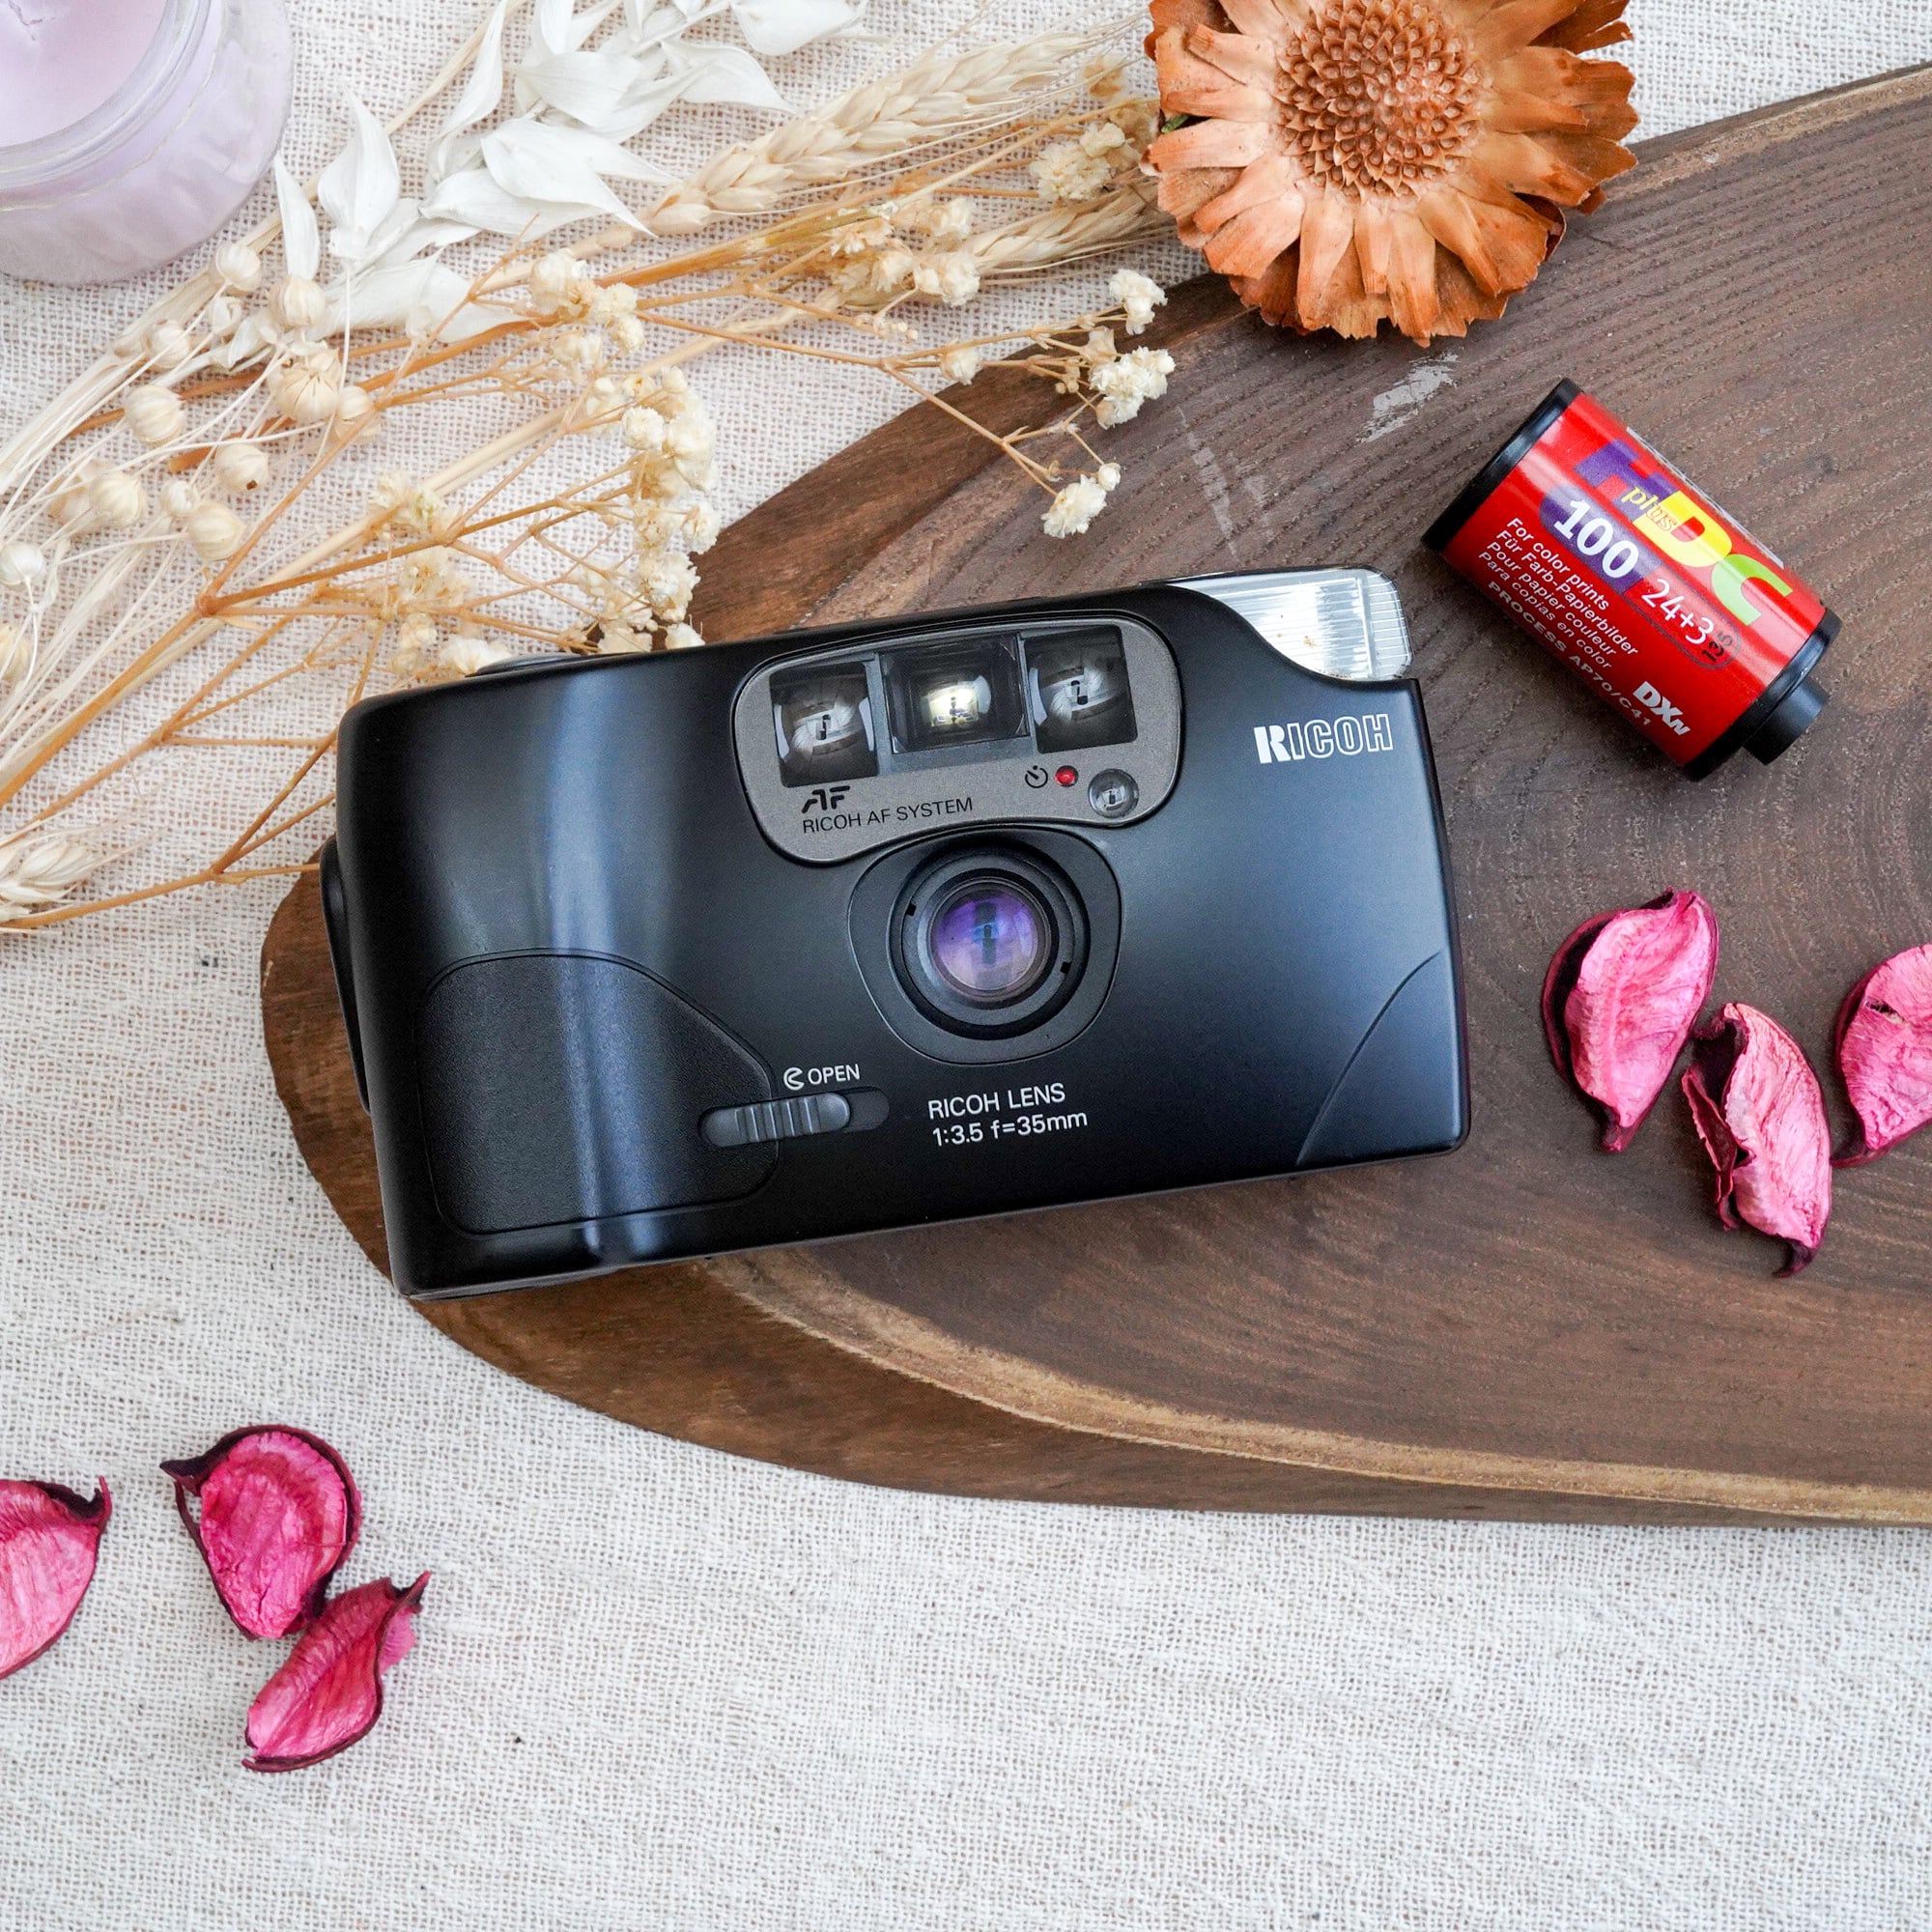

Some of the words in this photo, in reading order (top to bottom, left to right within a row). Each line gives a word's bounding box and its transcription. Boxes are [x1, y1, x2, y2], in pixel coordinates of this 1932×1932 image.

[1621, 487, 1677, 531] plus
[1507, 518, 1534, 541] For
[1533, 542, 1571, 573] color
[1566, 574, 1609, 610] prints
[1553, 499, 1639, 579] 100
[1478, 552, 1511, 581] Para
[1512, 582, 1556, 621] copias
[1557, 622, 1575, 638] en
[1576, 639, 1612, 668] color
[1487, 542, 1521, 571] Pour
[1519, 573, 1566, 610] papier
[1565, 611, 1616, 655] couleur
[1496, 530, 1522, 553] Für
[1521, 552, 1638, 654] Farb-Papierbilder
[1641, 578, 1715, 644] 24+3
[1489, 581, 1567, 651] PROCESS
[1569, 655, 1651, 725] AP70/C41
[1701, 631, 1733, 663] 135
[1254, 713, 1394, 764] RICOH
[802, 785, 851, 814] AF
[802, 812, 862, 834] RICOH
[867, 809, 892, 825] AF
[895, 796, 974, 821] SYSTEM
[807, 1064, 861, 1086] OPEN
[927, 1096, 1001, 1120] RICOH
[1009, 1082, 1065, 1109] LENS
[932, 1122, 983, 1147] 1:3.5
[990, 1111, 1088, 1140] f=35mm
